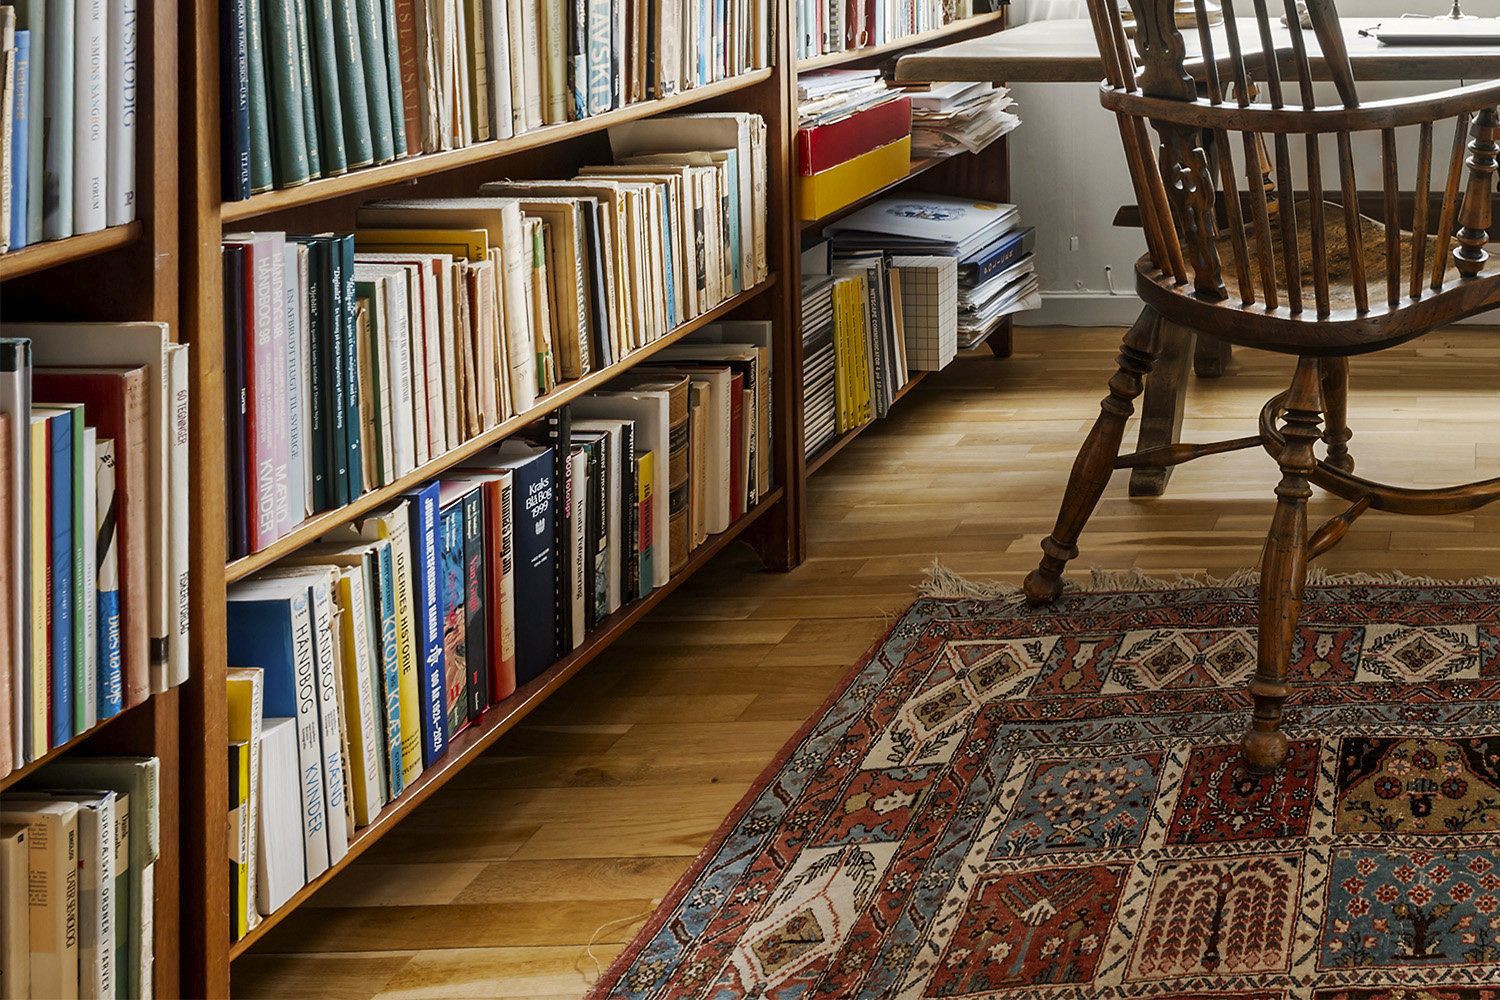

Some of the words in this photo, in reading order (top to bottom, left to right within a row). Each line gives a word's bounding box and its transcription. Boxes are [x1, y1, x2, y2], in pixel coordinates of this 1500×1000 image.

[90, 36, 100, 82] SIMONS
[91, 84, 99, 141] SANGBOG
[92, 176, 100, 210] FORUM
[258, 257, 272, 325] HÅNDBOG
[287, 288, 295, 303] EN
[259, 326, 270, 346] 98
[287, 306, 296, 355] AFBRUDT
[871, 320, 880, 366] COMMUNICATOR
[177, 390, 187, 400] 60
[288, 358, 297, 393] FLUGT
[176, 401, 187, 447] TEGNINGER
[289, 395, 298, 413] TIL
[290, 414, 300, 460] SVERIGE
[259, 458, 274, 536] KVINDER
[529, 477, 550, 496] Kraks
[531, 499, 548, 519] 1999
[576, 500, 584, 534] Kreativ
[397, 552, 407, 615] IDEERNES
[426, 530, 437, 605] IDRÆTSFORENING
[469, 555, 479, 579] Van
[575, 537, 584, 600] Fotografering
[353, 581, 364, 621] RUTH
[468, 579, 481, 613] Gogh
[357, 622, 368, 672] BERLAU
[382, 612, 398, 675] KROP
[400, 616, 411, 676] HISTORIE
[428, 606, 438, 642] HAKOAH
[108, 650, 121, 668] en
[295, 624, 314, 715] HÅNDBOG
[317, 613, 334, 702] HÅNDBOG
[430, 669, 440, 687] 100
[104, 669, 122, 704] skriv
[360, 677, 372, 733] BRECHTS
[432, 687, 441, 702] ÅR
[384, 689, 401, 751] KLÆR
[303, 762, 321, 837] KVINDER
[327, 751, 343, 808] MÆND
[101, 807, 109, 882] EUROPÆISKE
[101, 889, 109, 935] ORDNER
[101, 949, 109, 993] FARVER
